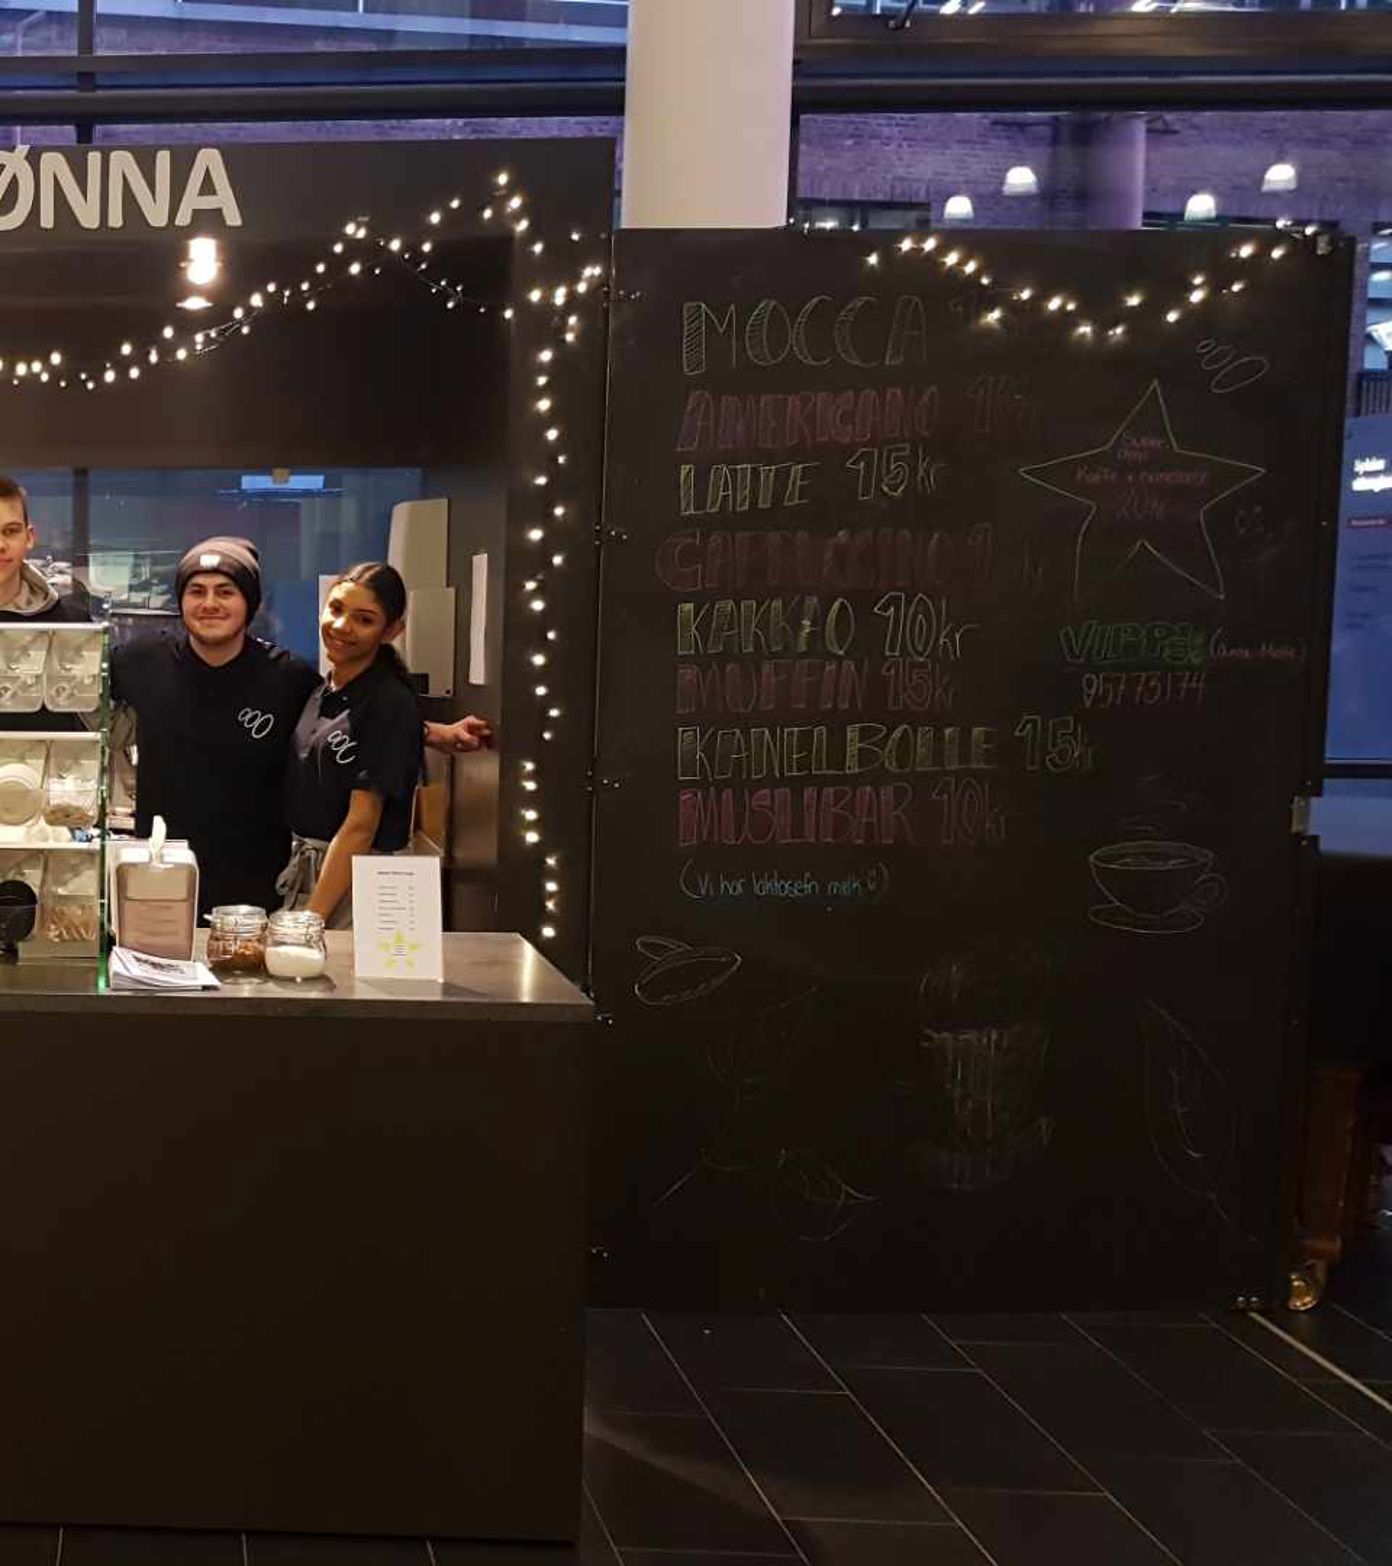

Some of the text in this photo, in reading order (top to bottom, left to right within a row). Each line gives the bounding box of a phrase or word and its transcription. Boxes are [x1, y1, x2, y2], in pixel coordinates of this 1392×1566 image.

[682, 295, 928, 375] MOCCA
[679, 461, 822, 517] LATTE
[676, 722, 999, 780] KANELBOLLE
